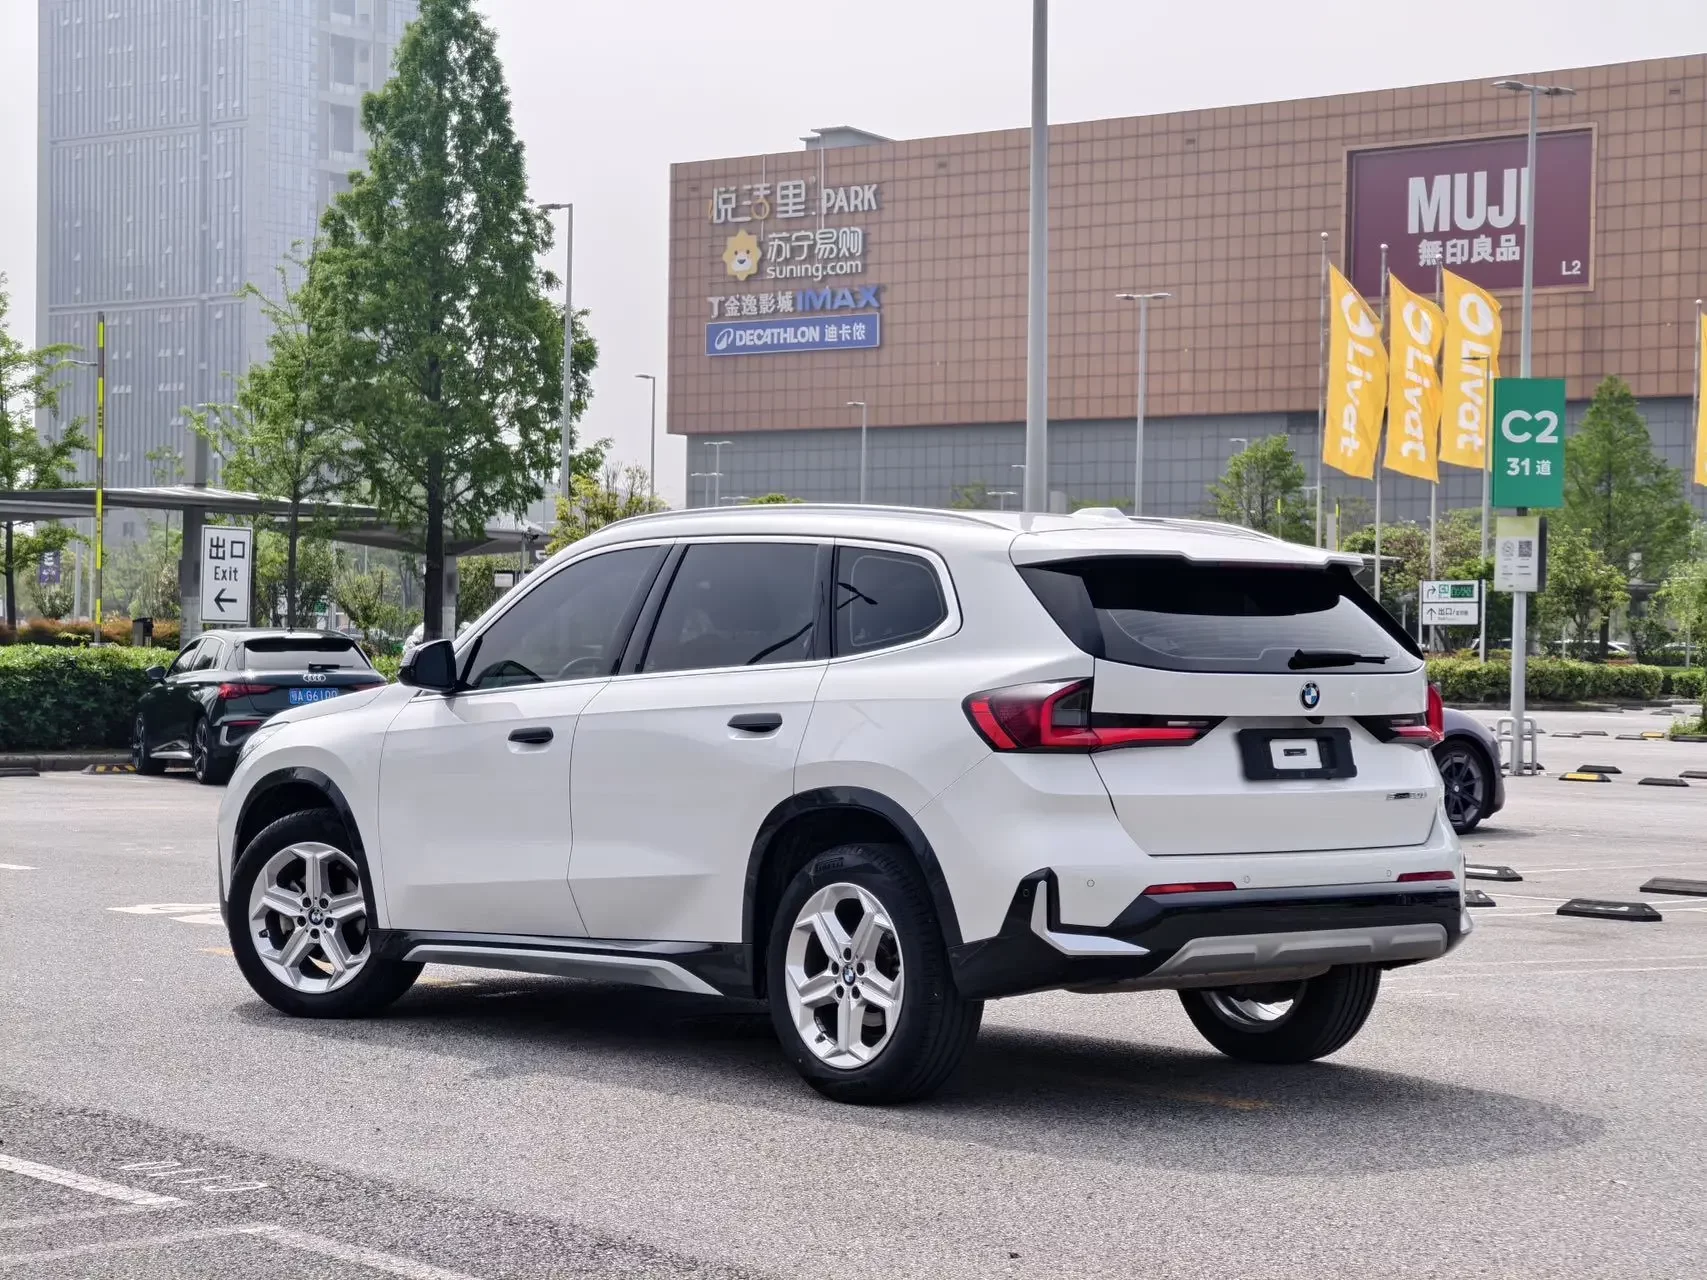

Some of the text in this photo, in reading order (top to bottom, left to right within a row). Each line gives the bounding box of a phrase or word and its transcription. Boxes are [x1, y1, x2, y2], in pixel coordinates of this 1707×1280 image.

[1408, 167, 1528, 234] MUJI
[767, 226, 863, 262] 苏宁易购
[1418, 234, 1520, 267] 無印良品
[766, 259, 863, 281] suning.com
[1561, 260, 1581, 276] L2
[724, 290, 795, 317] 金逸影城
[795, 284, 881, 312] IMAX
[735, 322, 867, 347] DECATHLON 迪卡侬
[1501, 409, 1559, 444] C2
[208, 535, 246, 561] 出口
[213, 565, 239, 582] Exit
